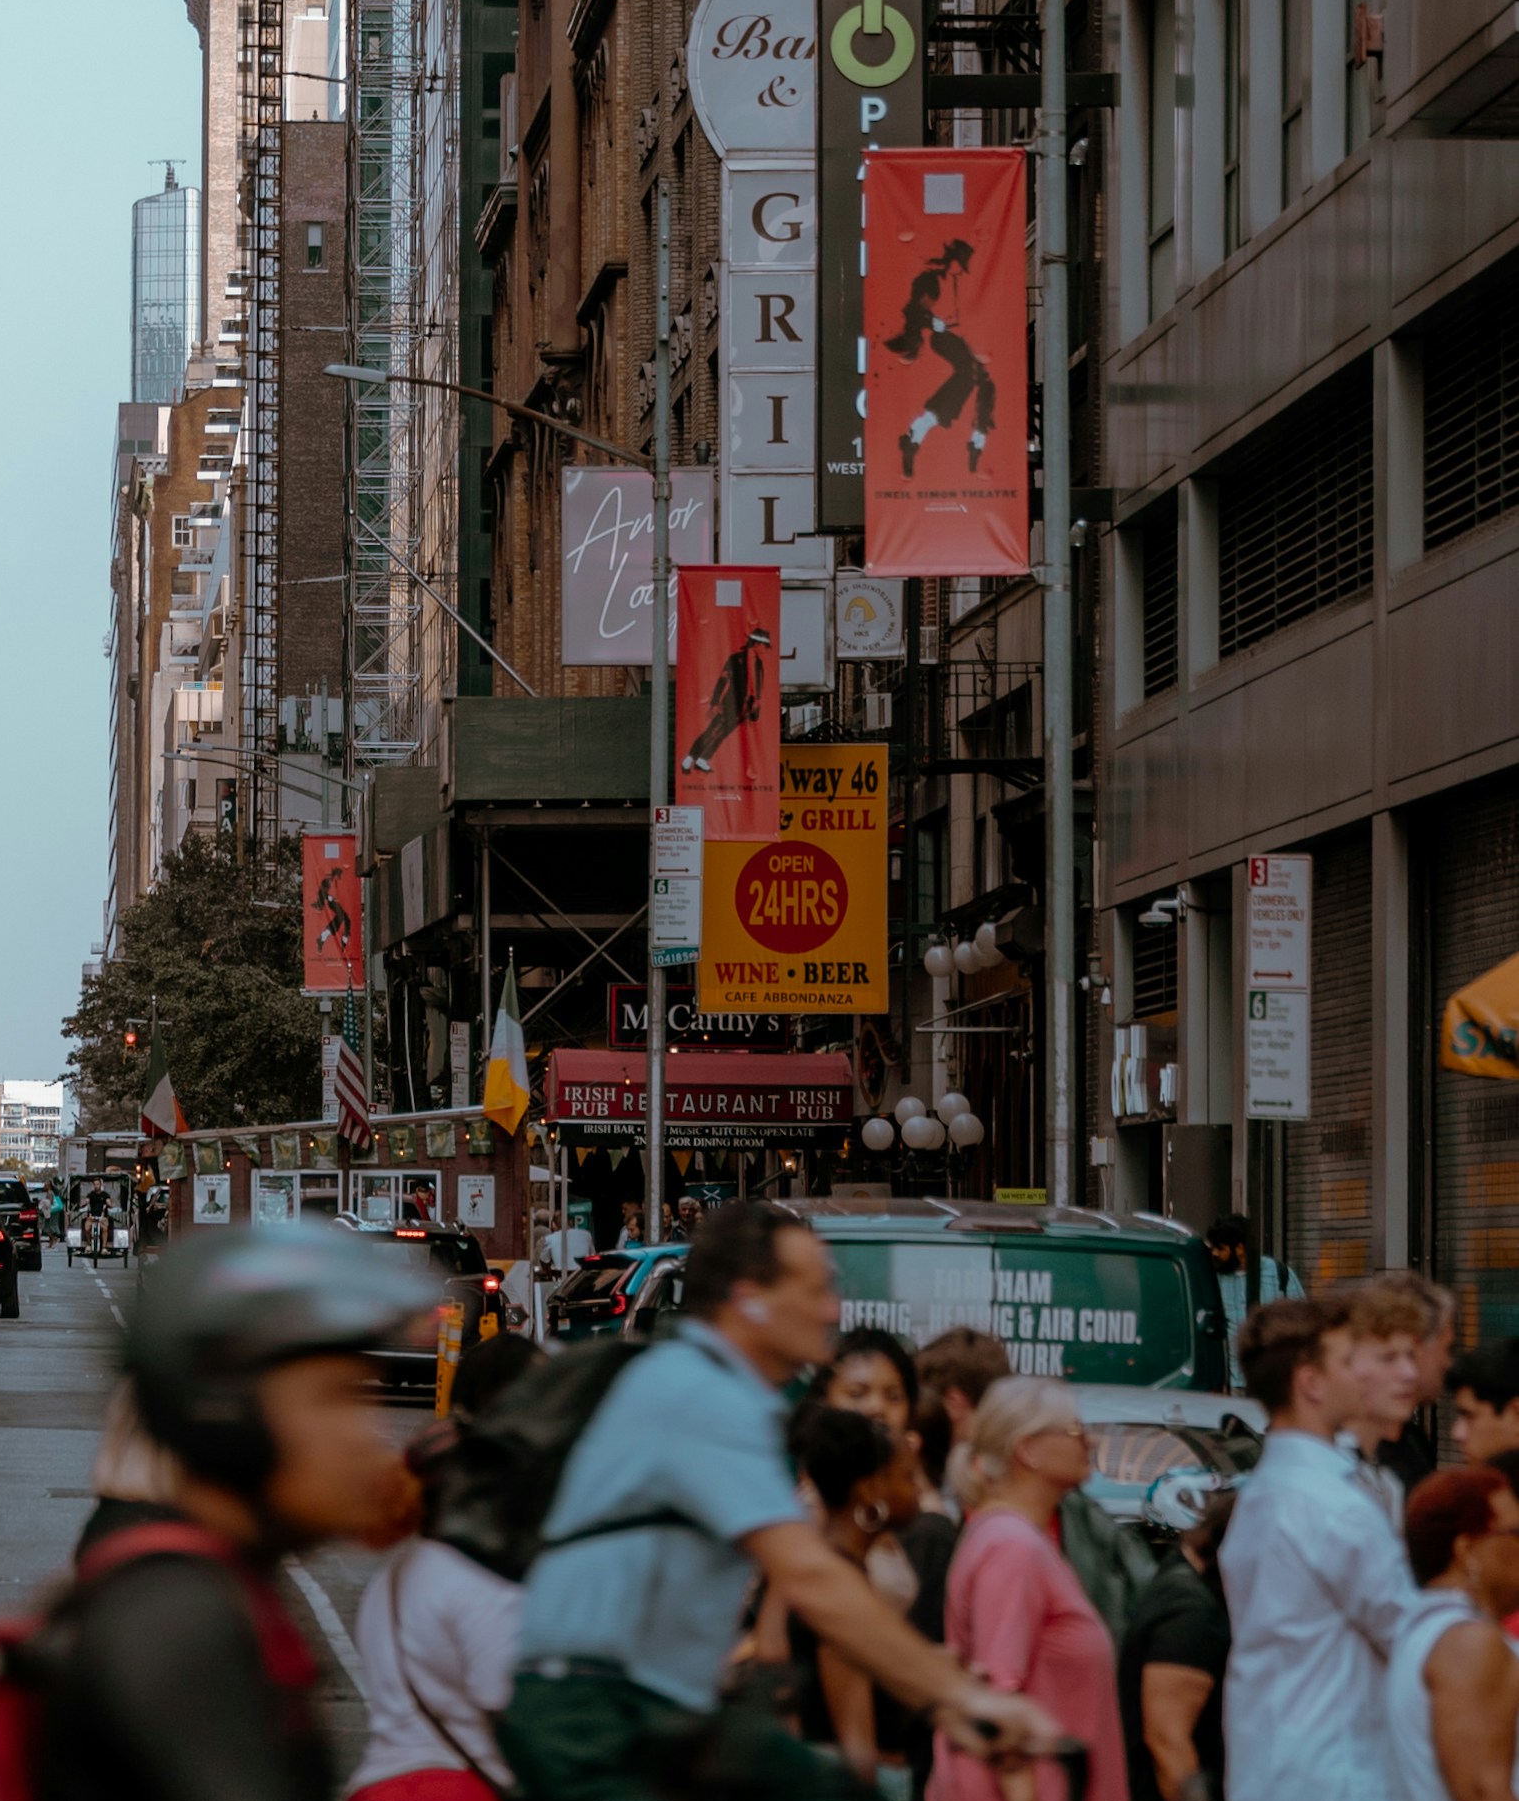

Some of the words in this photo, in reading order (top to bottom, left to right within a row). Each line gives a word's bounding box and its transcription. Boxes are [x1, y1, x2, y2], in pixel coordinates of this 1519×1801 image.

[757, 75, 802, 108] &
[751, 191, 804, 660] GRIL
[851, 760, 878, 796] 46
[657, 809, 668, 823] 3
[801, 809, 876, 831] GRILL
[769, 855, 814, 873] OPEN
[1254, 860, 1266, 885] 3
[656, 880, 666, 894] 6
[748, 879, 839, 926] 24HRS
[714, 962, 780, 985] WINE
[803, 961, 870, 984] BEER
[724, 992, 758, 1003] CAFE
[762, 992, 854, 1005] ABBONDANZA
[1253, 993, 1264, 1018] 6
[564, 1086, 617, 1102] IRISH
[622, 1092, 781, 1114] RETAURANT
[789, 1090, 841, 1105] IRISH
[571, 1101, 610, 1117] PUB
[795, 1105, 834, 1120] PUB
[583, 1124, 612, 1134] IRISH
[613, 1125, 635, 1135] BAR
[669, 1127, 703, 1136] MUSIC
[711, 1127, 758, 1137] KITCHEN
[759, 1128, 787, 1137] OPEN
[789, 1128, 816, 1137] LATE
[633, 1136, 648, 1146] 2N
[663, 1136, 690, 1147] LOOR
[693, 1137, 731, 1148] DINING
[733, 1138, 765, 1148] ROOM
[1018, 1306, 1036, 1339] &
[1037, 1308, 1075, 1342] AIR
[1079, 1309, 1142, 1345] COND.
